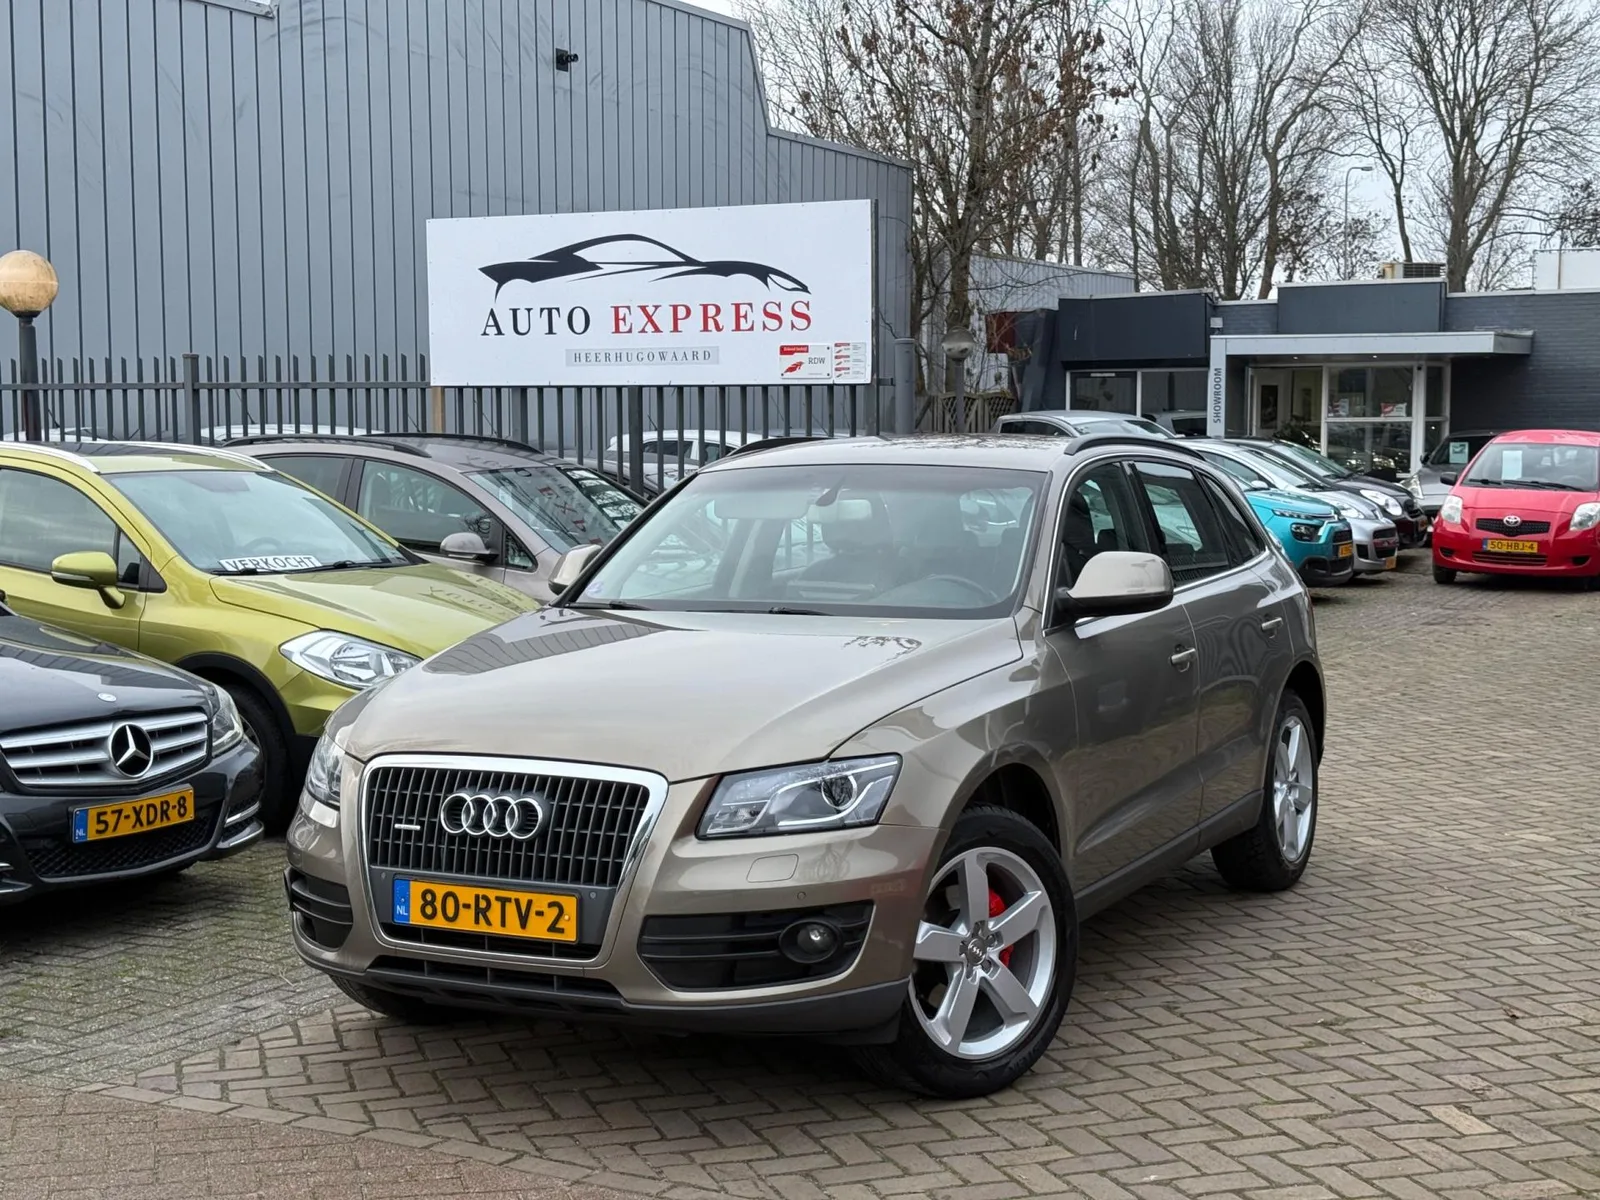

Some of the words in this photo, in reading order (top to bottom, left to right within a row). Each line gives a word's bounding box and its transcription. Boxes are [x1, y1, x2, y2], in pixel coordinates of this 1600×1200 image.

[481, 306, 591, 336] AUTO
[610, 300, 812, 334] EXPRESS
[574, 350, 711, 363] HEERHUGOWAARD
[1213, 367, 1222, 424] SHOWROOM
[1490, 540, 1535, 551] 50-HBJ-4
[95, 796, 187, 835] 57-XDR-8
[76, 828, 86, 837] NL
[396, 904, 408, 916] NL
[420, 888, 565, 934] 80-RTV-2
